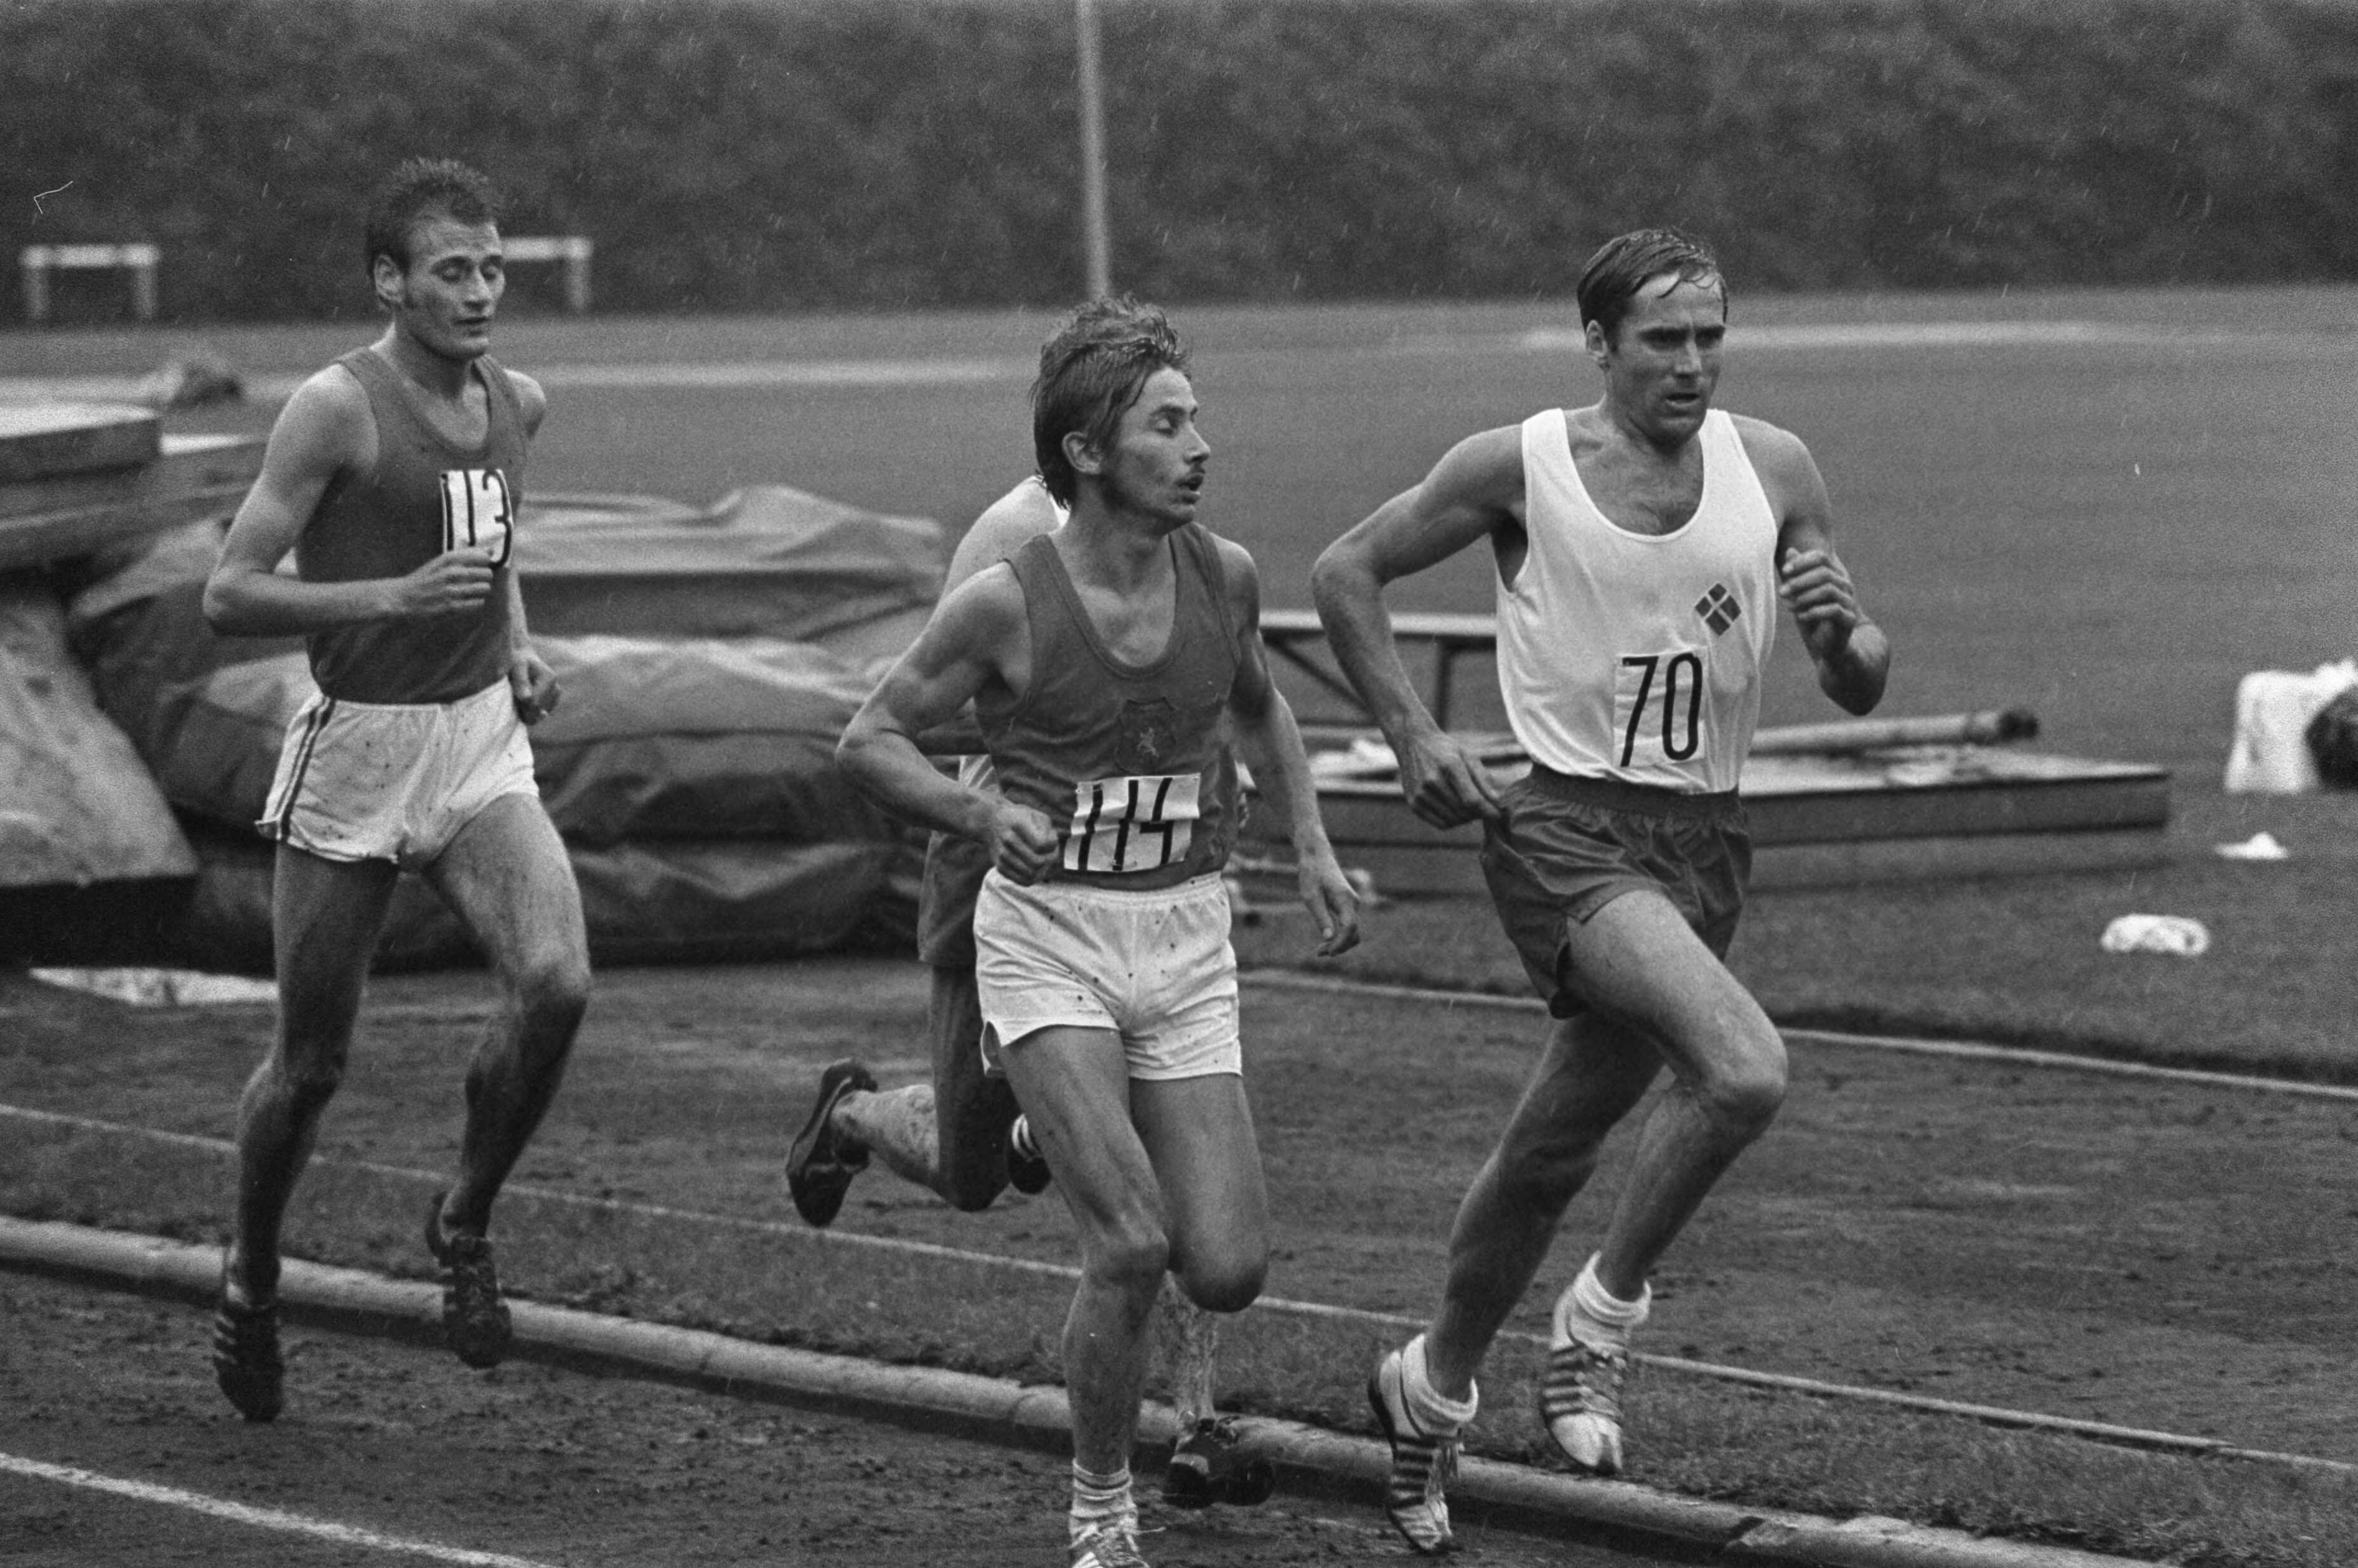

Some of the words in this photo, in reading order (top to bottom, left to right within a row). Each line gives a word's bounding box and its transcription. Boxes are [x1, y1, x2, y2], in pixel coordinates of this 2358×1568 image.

[442, 471, 512, 567] 113
[1620, 653, 1702, 767] 70
[1078, 777, 1174, 871] 114
